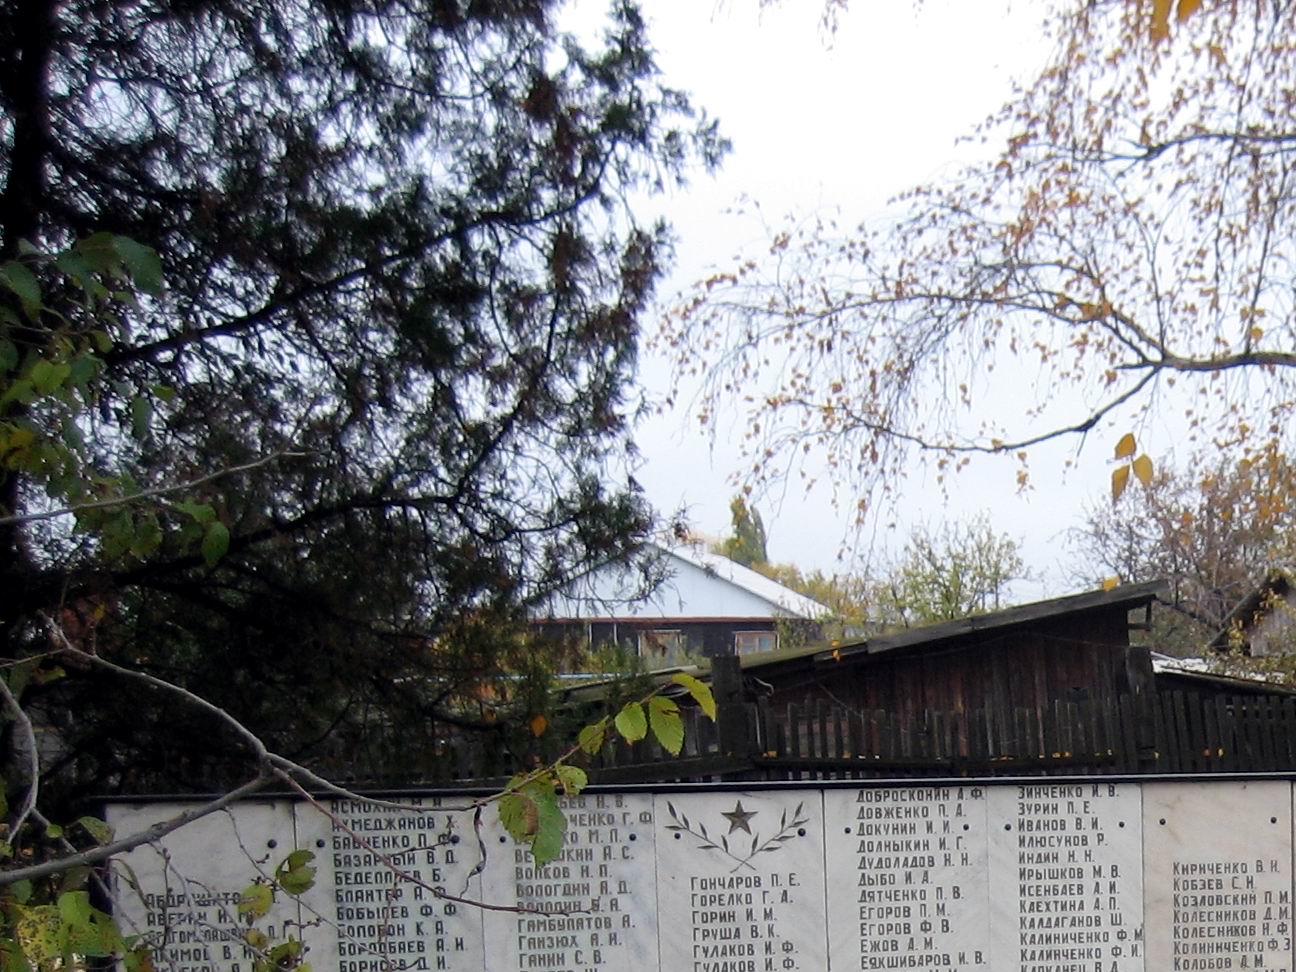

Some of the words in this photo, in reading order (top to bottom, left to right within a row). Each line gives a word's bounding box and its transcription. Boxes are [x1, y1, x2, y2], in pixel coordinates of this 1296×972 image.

[857, 806, 929, 820] ДОВЖЕНКО
[1018, 802, 1058, 815] ЗУРИН
[1018, 818, 1066, 832] ИВАНОВ
[858, 856, 935, 869] ДУДОЛАДОВ
[691, 875, 762, 891] ГОНЧАРОВ
[1173, 878, 1223, 892] КОБЗЕВ
[1020, 884, 1083, 897] ИСЕНБАЕВ
[691, 892, 752, 907] ГОРЕЛКО
[861, 923, 911, 936] ЕГОРОВ
[1020, 916, 1101, 930] КАЛДАГАНОВ
[693, 928, 740, 942] ГРУША
[519, 952, 565, 968] ГАНИН
